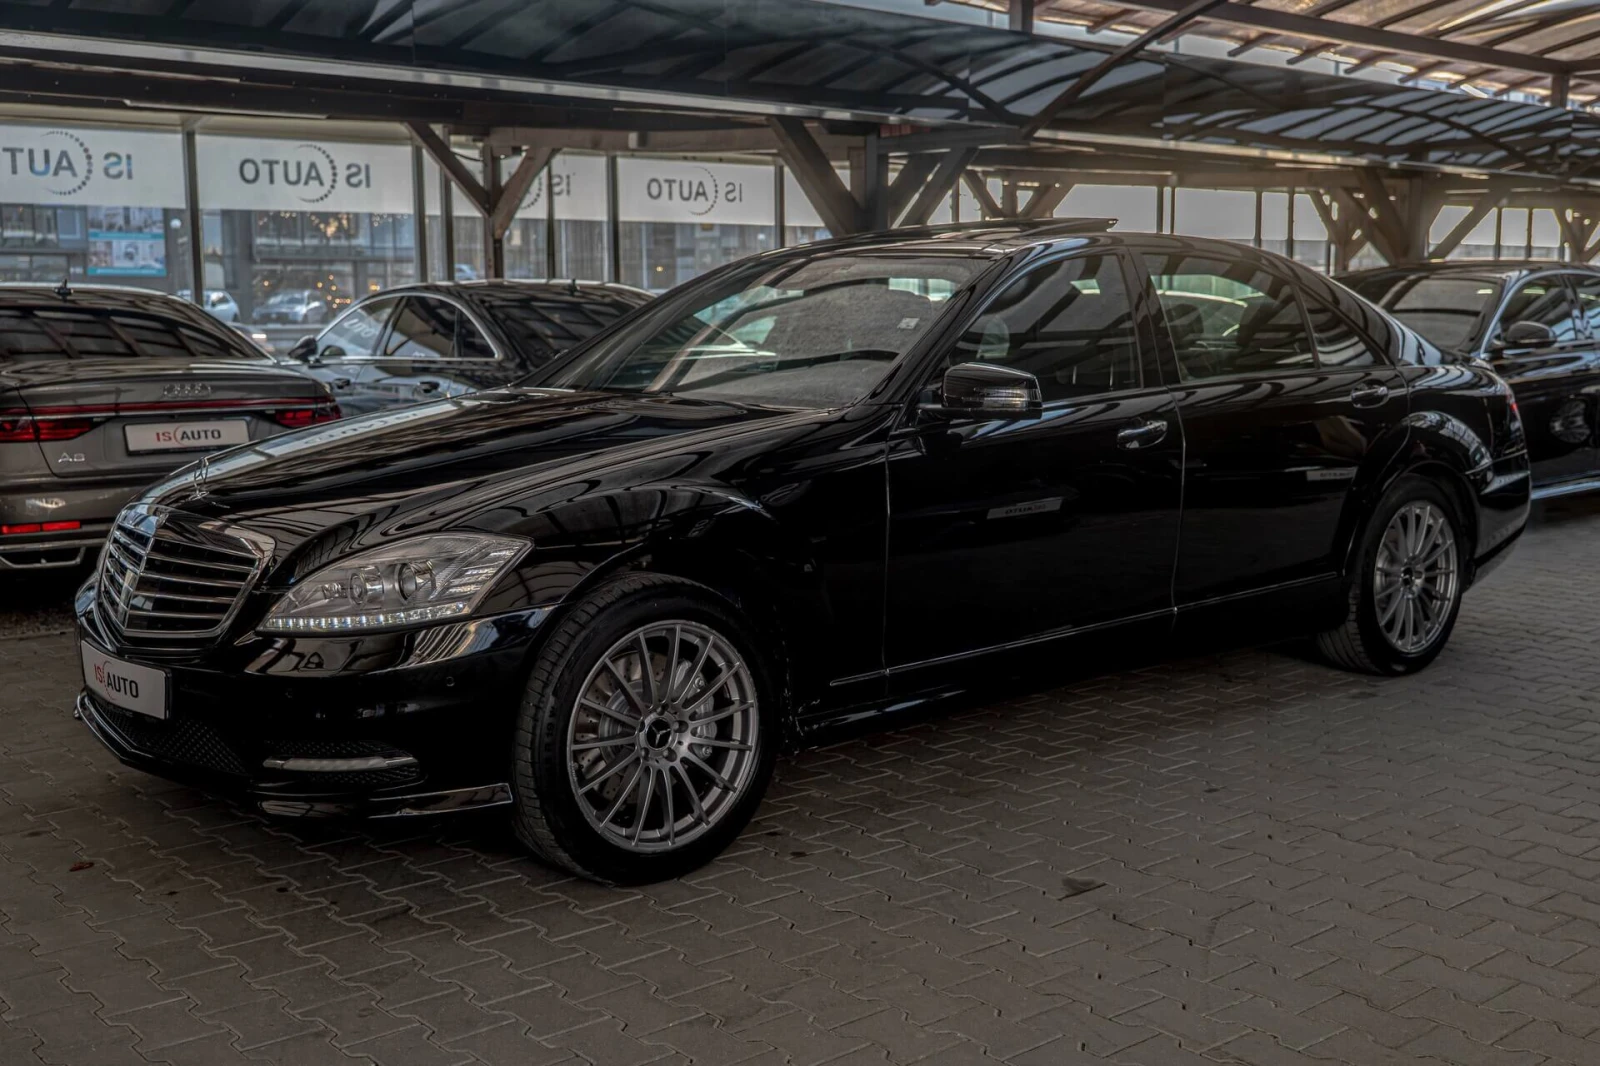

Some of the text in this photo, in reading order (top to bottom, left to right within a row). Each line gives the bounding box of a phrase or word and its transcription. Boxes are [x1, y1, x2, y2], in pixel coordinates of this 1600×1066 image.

[155, 429, 222, 442] IS AUTO
[94, 663, 139, 698] IS AUTO
